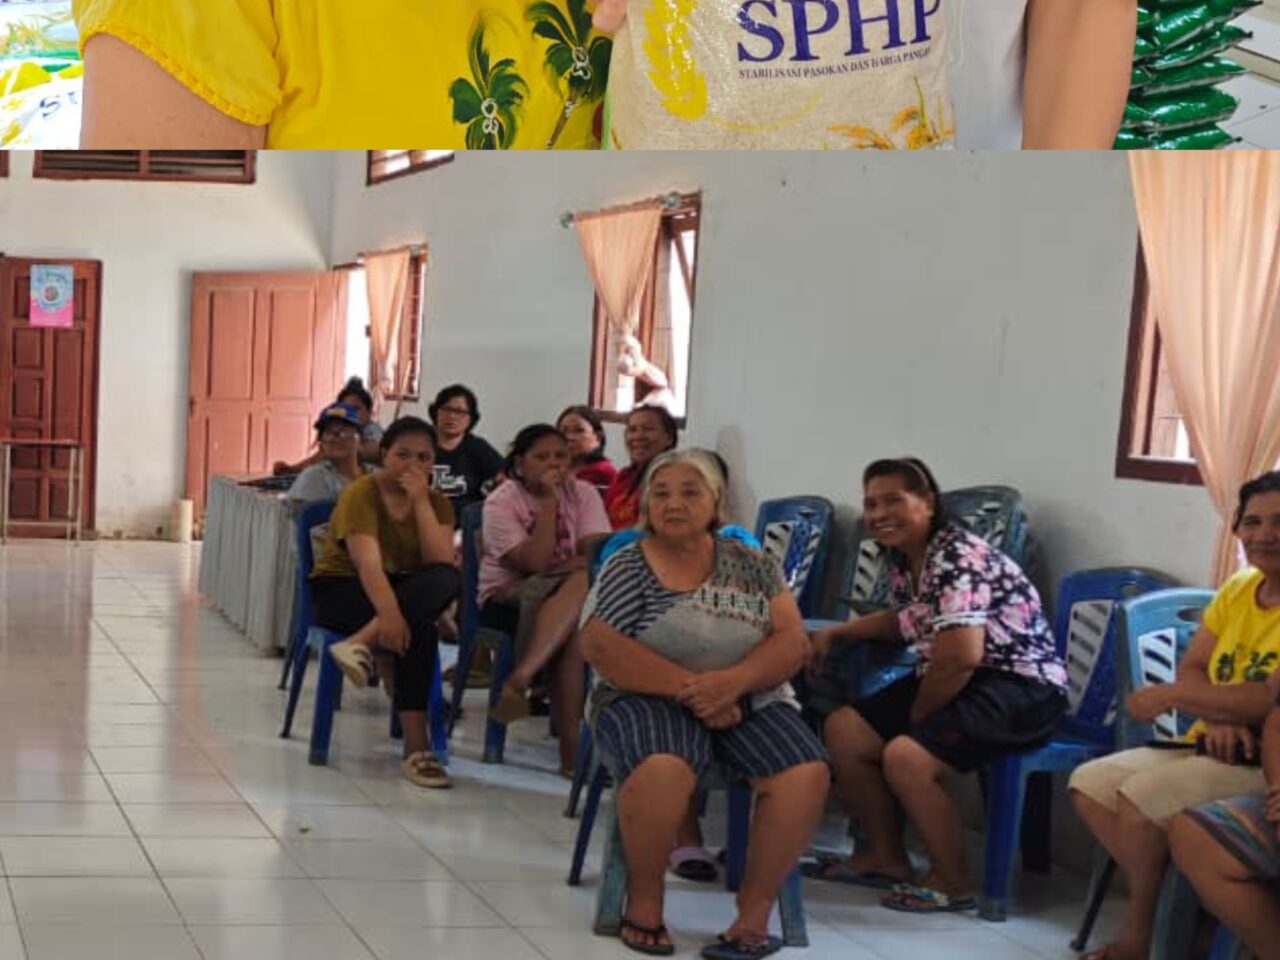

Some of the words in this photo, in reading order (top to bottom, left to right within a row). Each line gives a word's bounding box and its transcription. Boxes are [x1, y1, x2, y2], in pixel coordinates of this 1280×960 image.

[739, 67, 801, 80] STABILISASI
[803, 64, 850, 78] PASOKAN
[851, 60, 870, 72] DAN
[871, 55, 902, 70] HARGA
